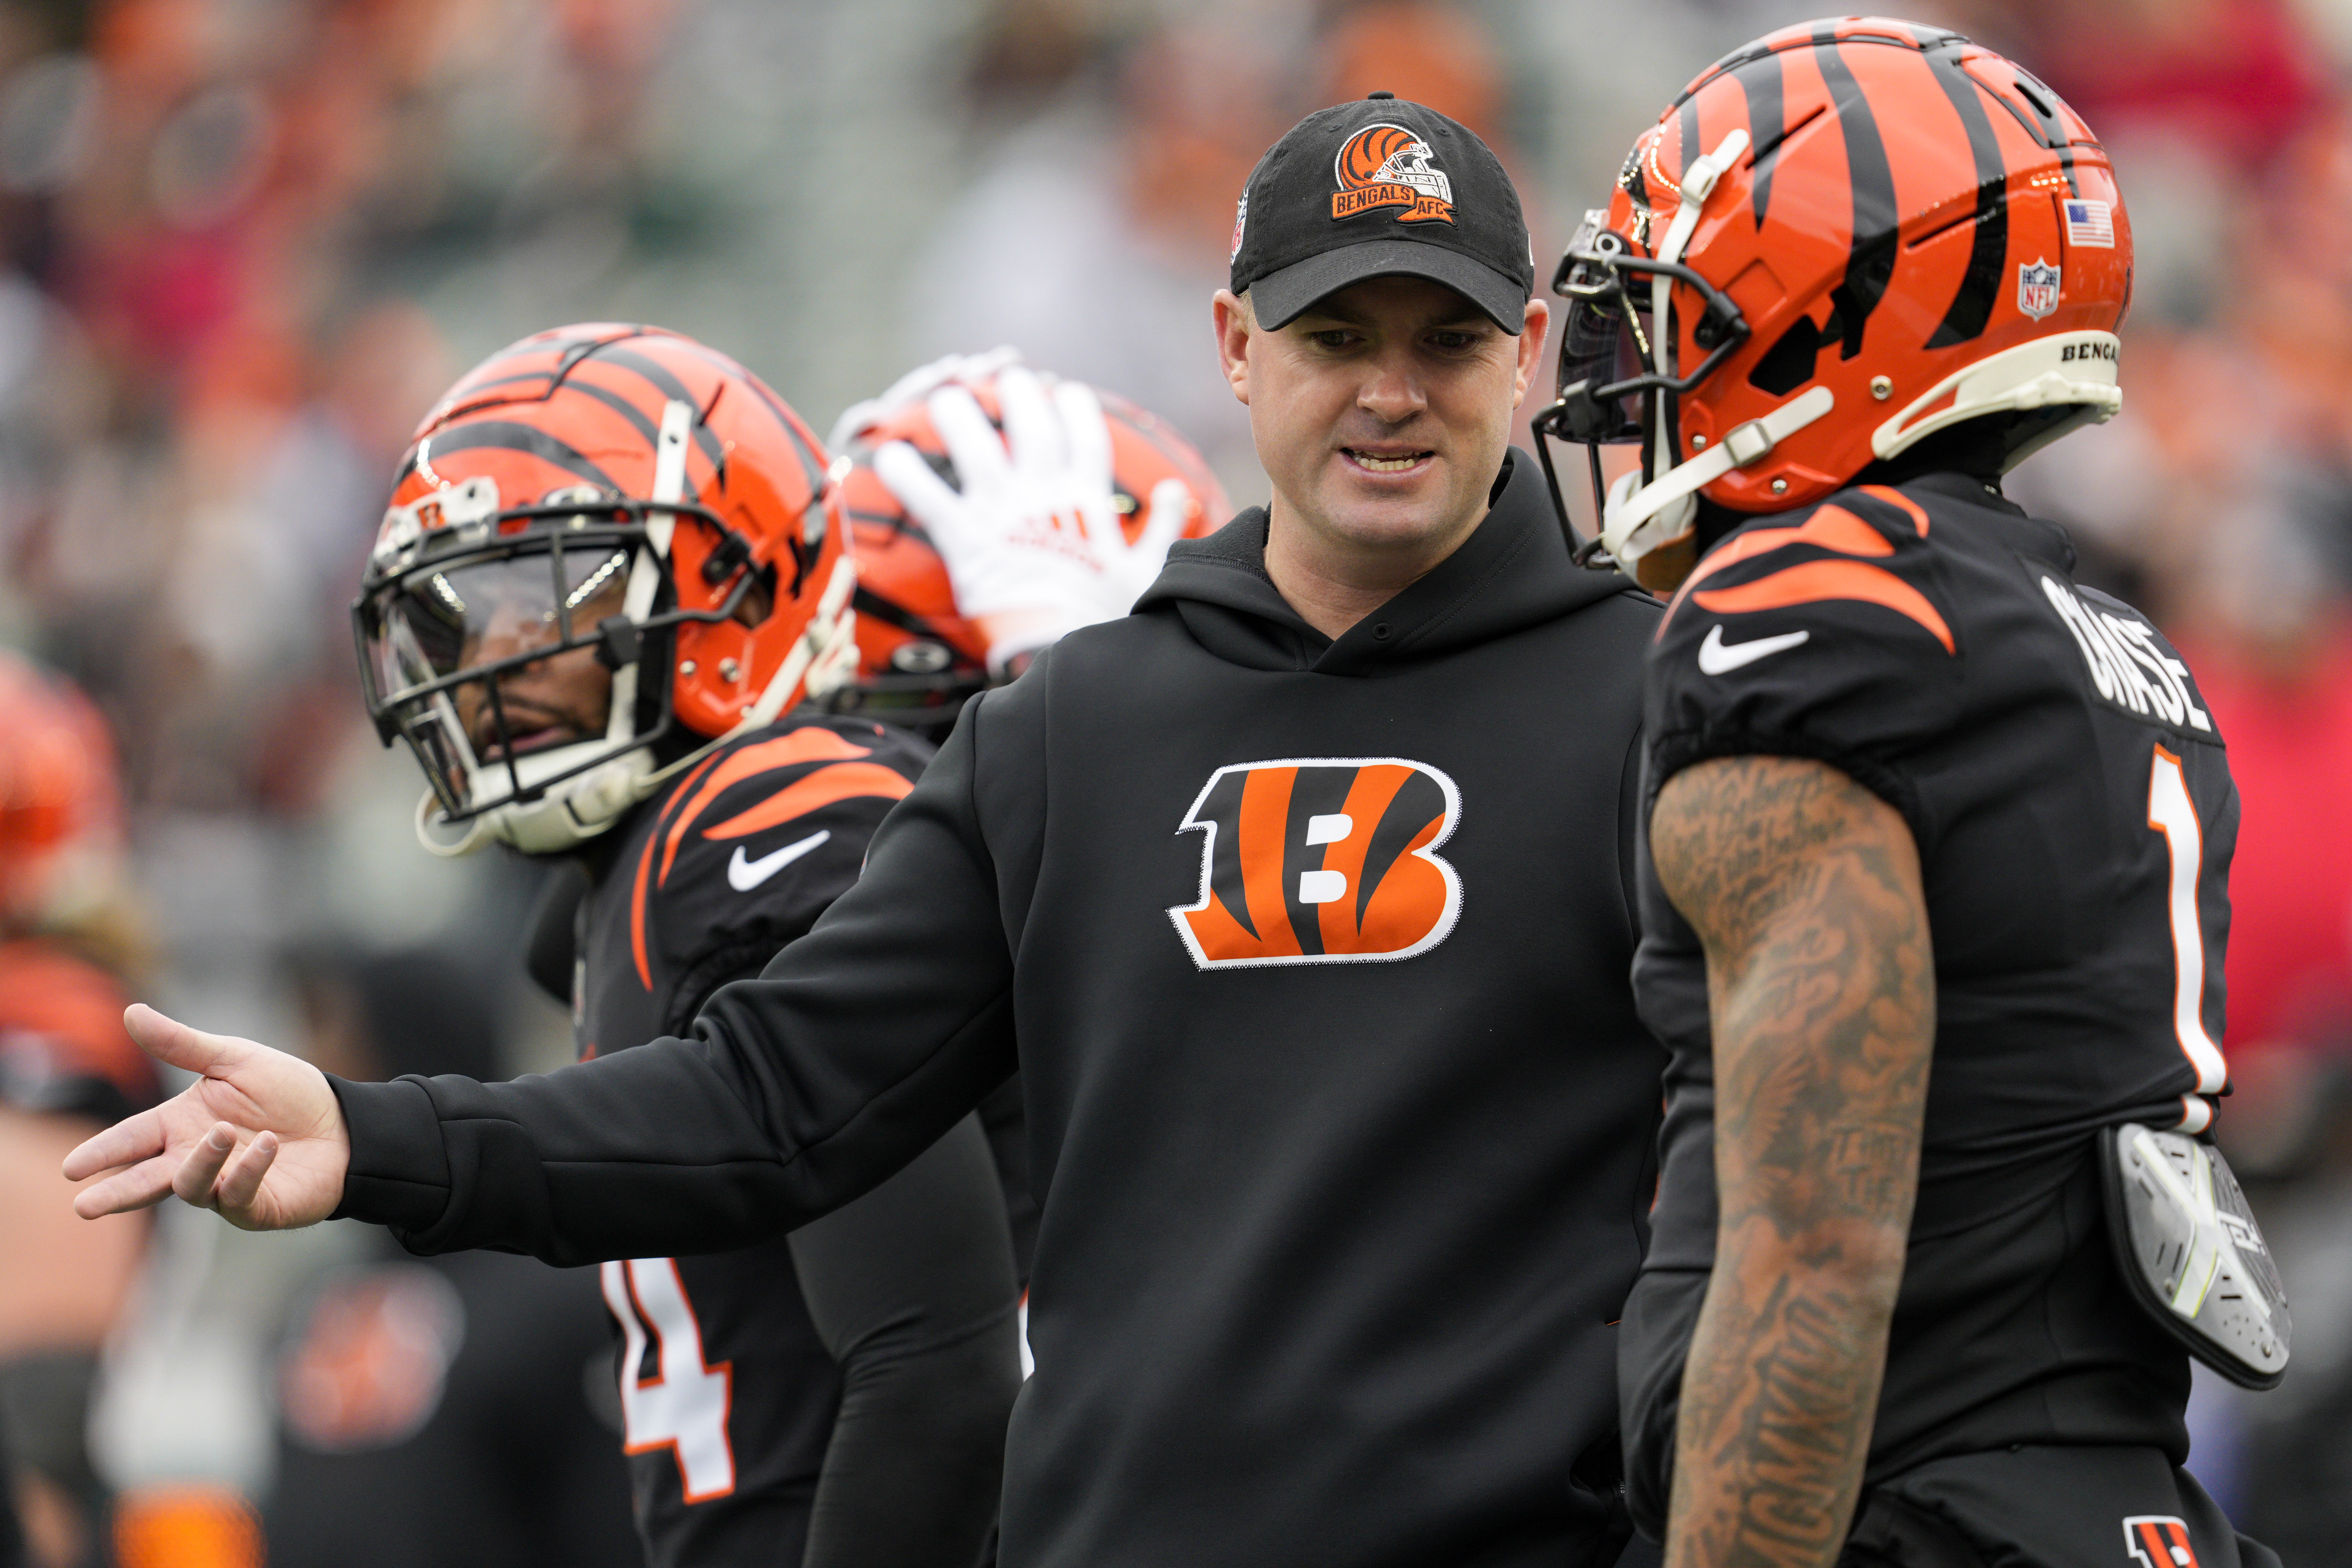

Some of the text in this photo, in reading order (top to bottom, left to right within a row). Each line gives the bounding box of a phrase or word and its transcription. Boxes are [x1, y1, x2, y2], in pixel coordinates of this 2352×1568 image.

[1336, 187, 1444, 215] BENGALS AFC
[2024, 286, 2054, 311] NFL
[2061, 342, 2120, 365] BENGA
[2041, 575, 2211, 732] CHASE
[2147, 742, 2229, 1135] 1
